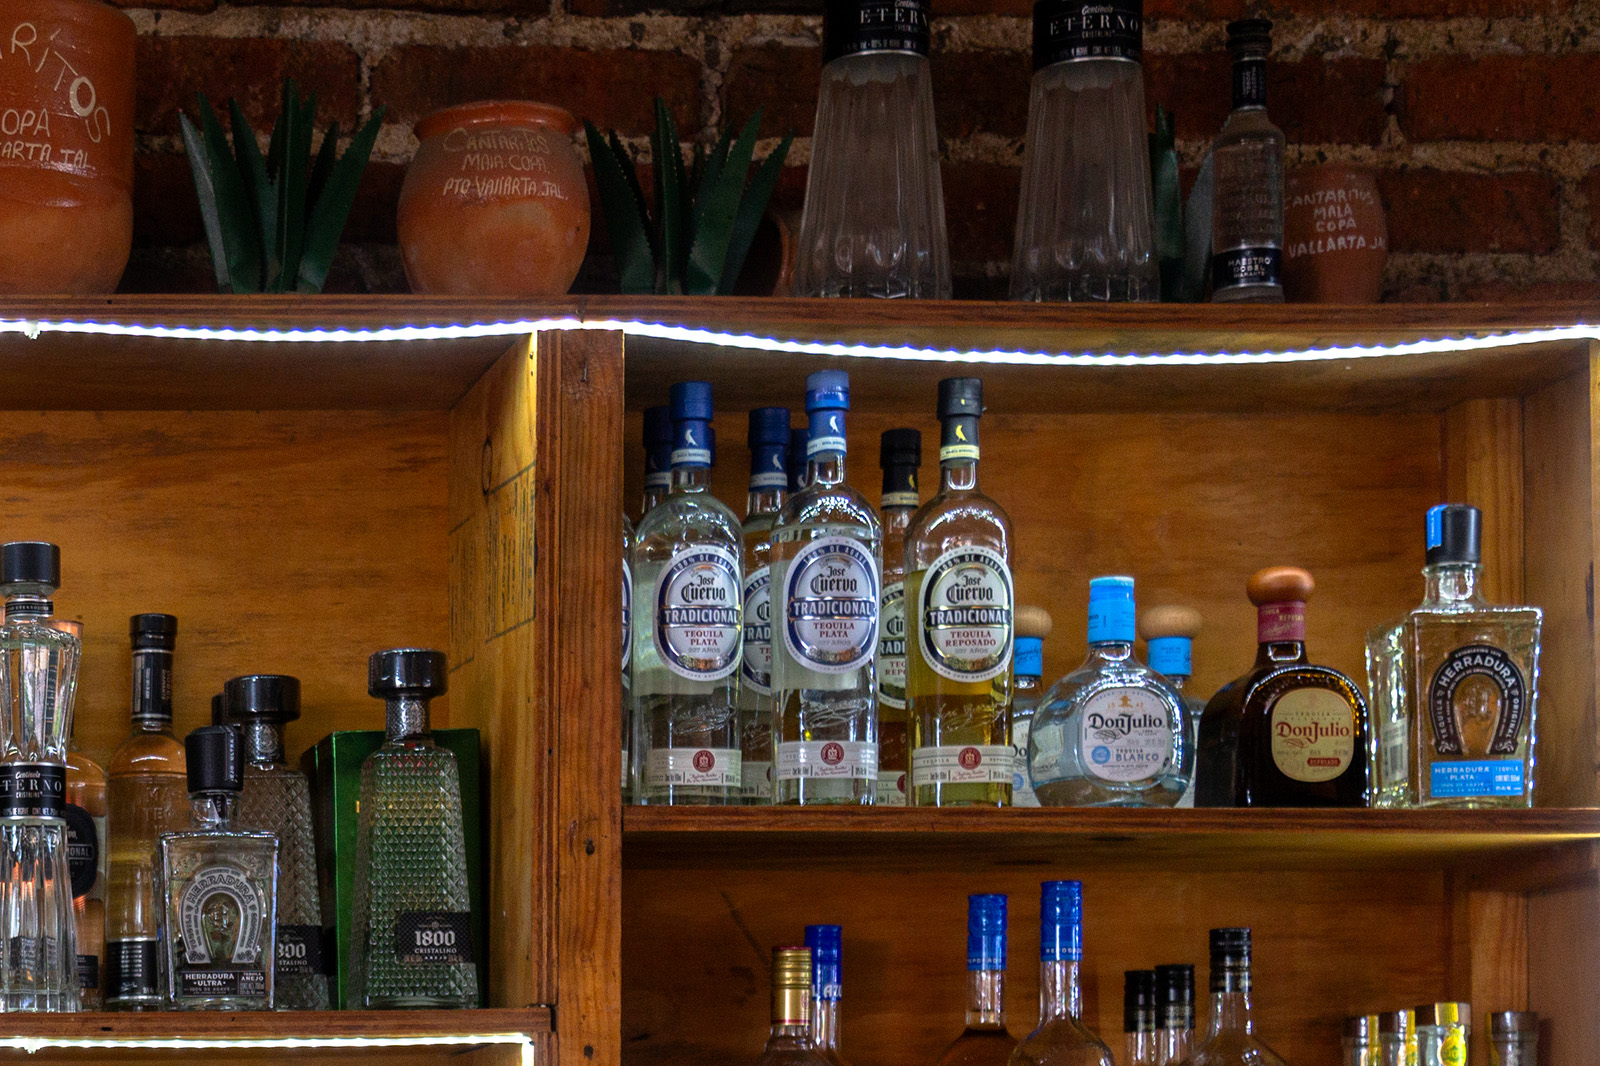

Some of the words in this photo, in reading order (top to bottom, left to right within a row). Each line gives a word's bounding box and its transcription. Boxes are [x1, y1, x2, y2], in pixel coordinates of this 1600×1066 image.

[1050, 12, 1139, 36] ETERNO
[1314, 203, 1352, 219] MALA
[1316, 219, 1358, 233] COPA
[1289, 235, 1366, 258] VALLARTA
[1228, 256, 1272, 268] MAESTRO
[1234, 265, 1266, 274] DOBEL
[826, 565, 846, 577] Jose
[698, 574, 714, 586] Jose
[810, 573, 858, 595] Cuervo
[962, 574, 982, 587] Jose
[680, 582, 727, 603] Cuervo
[946, 582, 994, 604] Cuervo
[793, 600, 872, 616] TRADICIONAL
[665, 608, 738, 623] TRADICIONAL
[929, 608, 1008, 624] TRADICIONAL
[813, 621, 855, 630] TEQUILA
[684, 630, 724, 638] TEQUILA
[819, 629, 849, 638] PLATA
[950, 630, 992, 639] TEQUILA
[689, 638, 718, 647] PLATA
[944, 638, 997, 647] REPOSADO
[1438, 655, 1516, 688] HERRADURA
[1437, 700, 1448, 739] TEQUILA
[1505, 697, 1520, 739] ORIGINAL
[1116, 753, 1160, 762] BLANCO
[1434, 766, 1490, 774] HERRADURA
[1449, 773, 1475, 781] PLATA
[186, 873, 256, 905] HERRADURA
[414, 929, 456, 947] 1800
[414, 947, 458, 955] CRISTALINO
[185, 973, 235, 981] HERRADURA
[197, 979, 223, 987] ULTRA
[241, 975, 264, 983] AÑEJO
